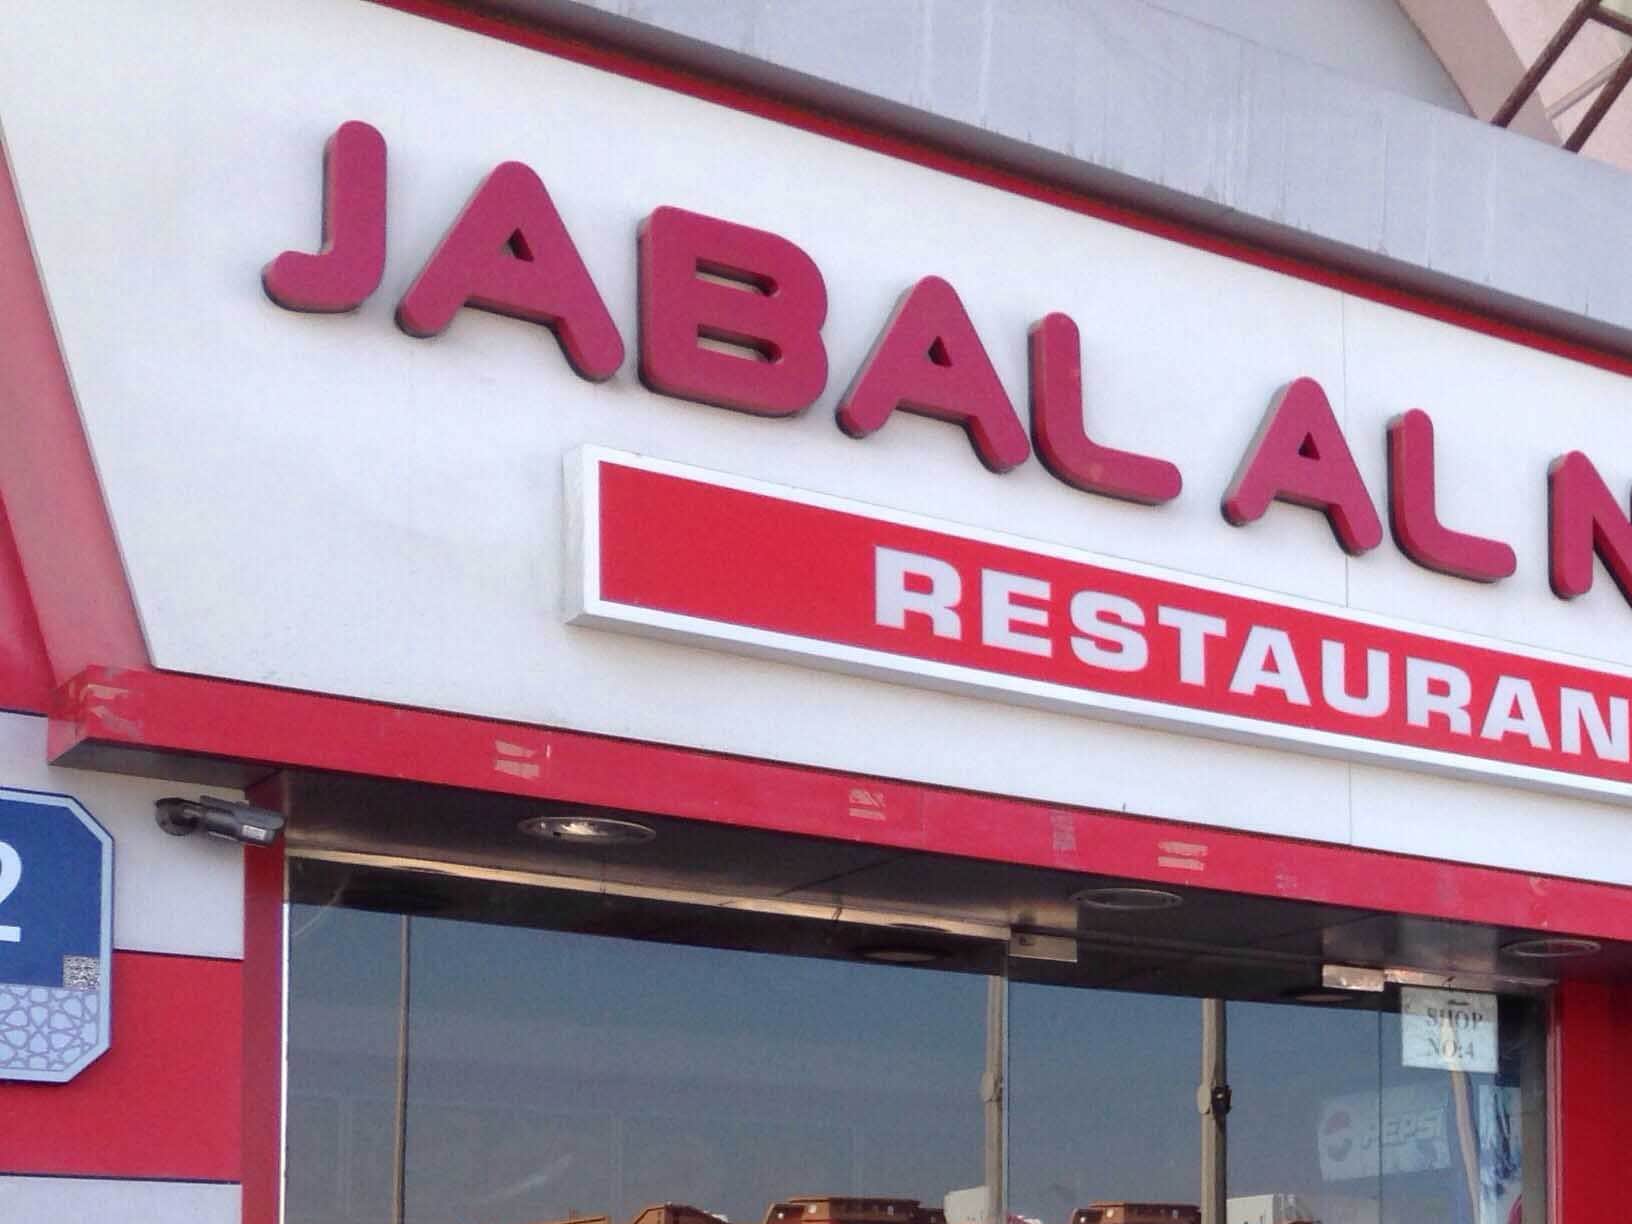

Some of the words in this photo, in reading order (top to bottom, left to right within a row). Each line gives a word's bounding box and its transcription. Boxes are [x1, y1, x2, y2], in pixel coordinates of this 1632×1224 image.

[262, 120, 1182, 506] JABAL
[1221, 376, 1517, 583] AL
[1425, 1007, 1484, 1031] SHOP
